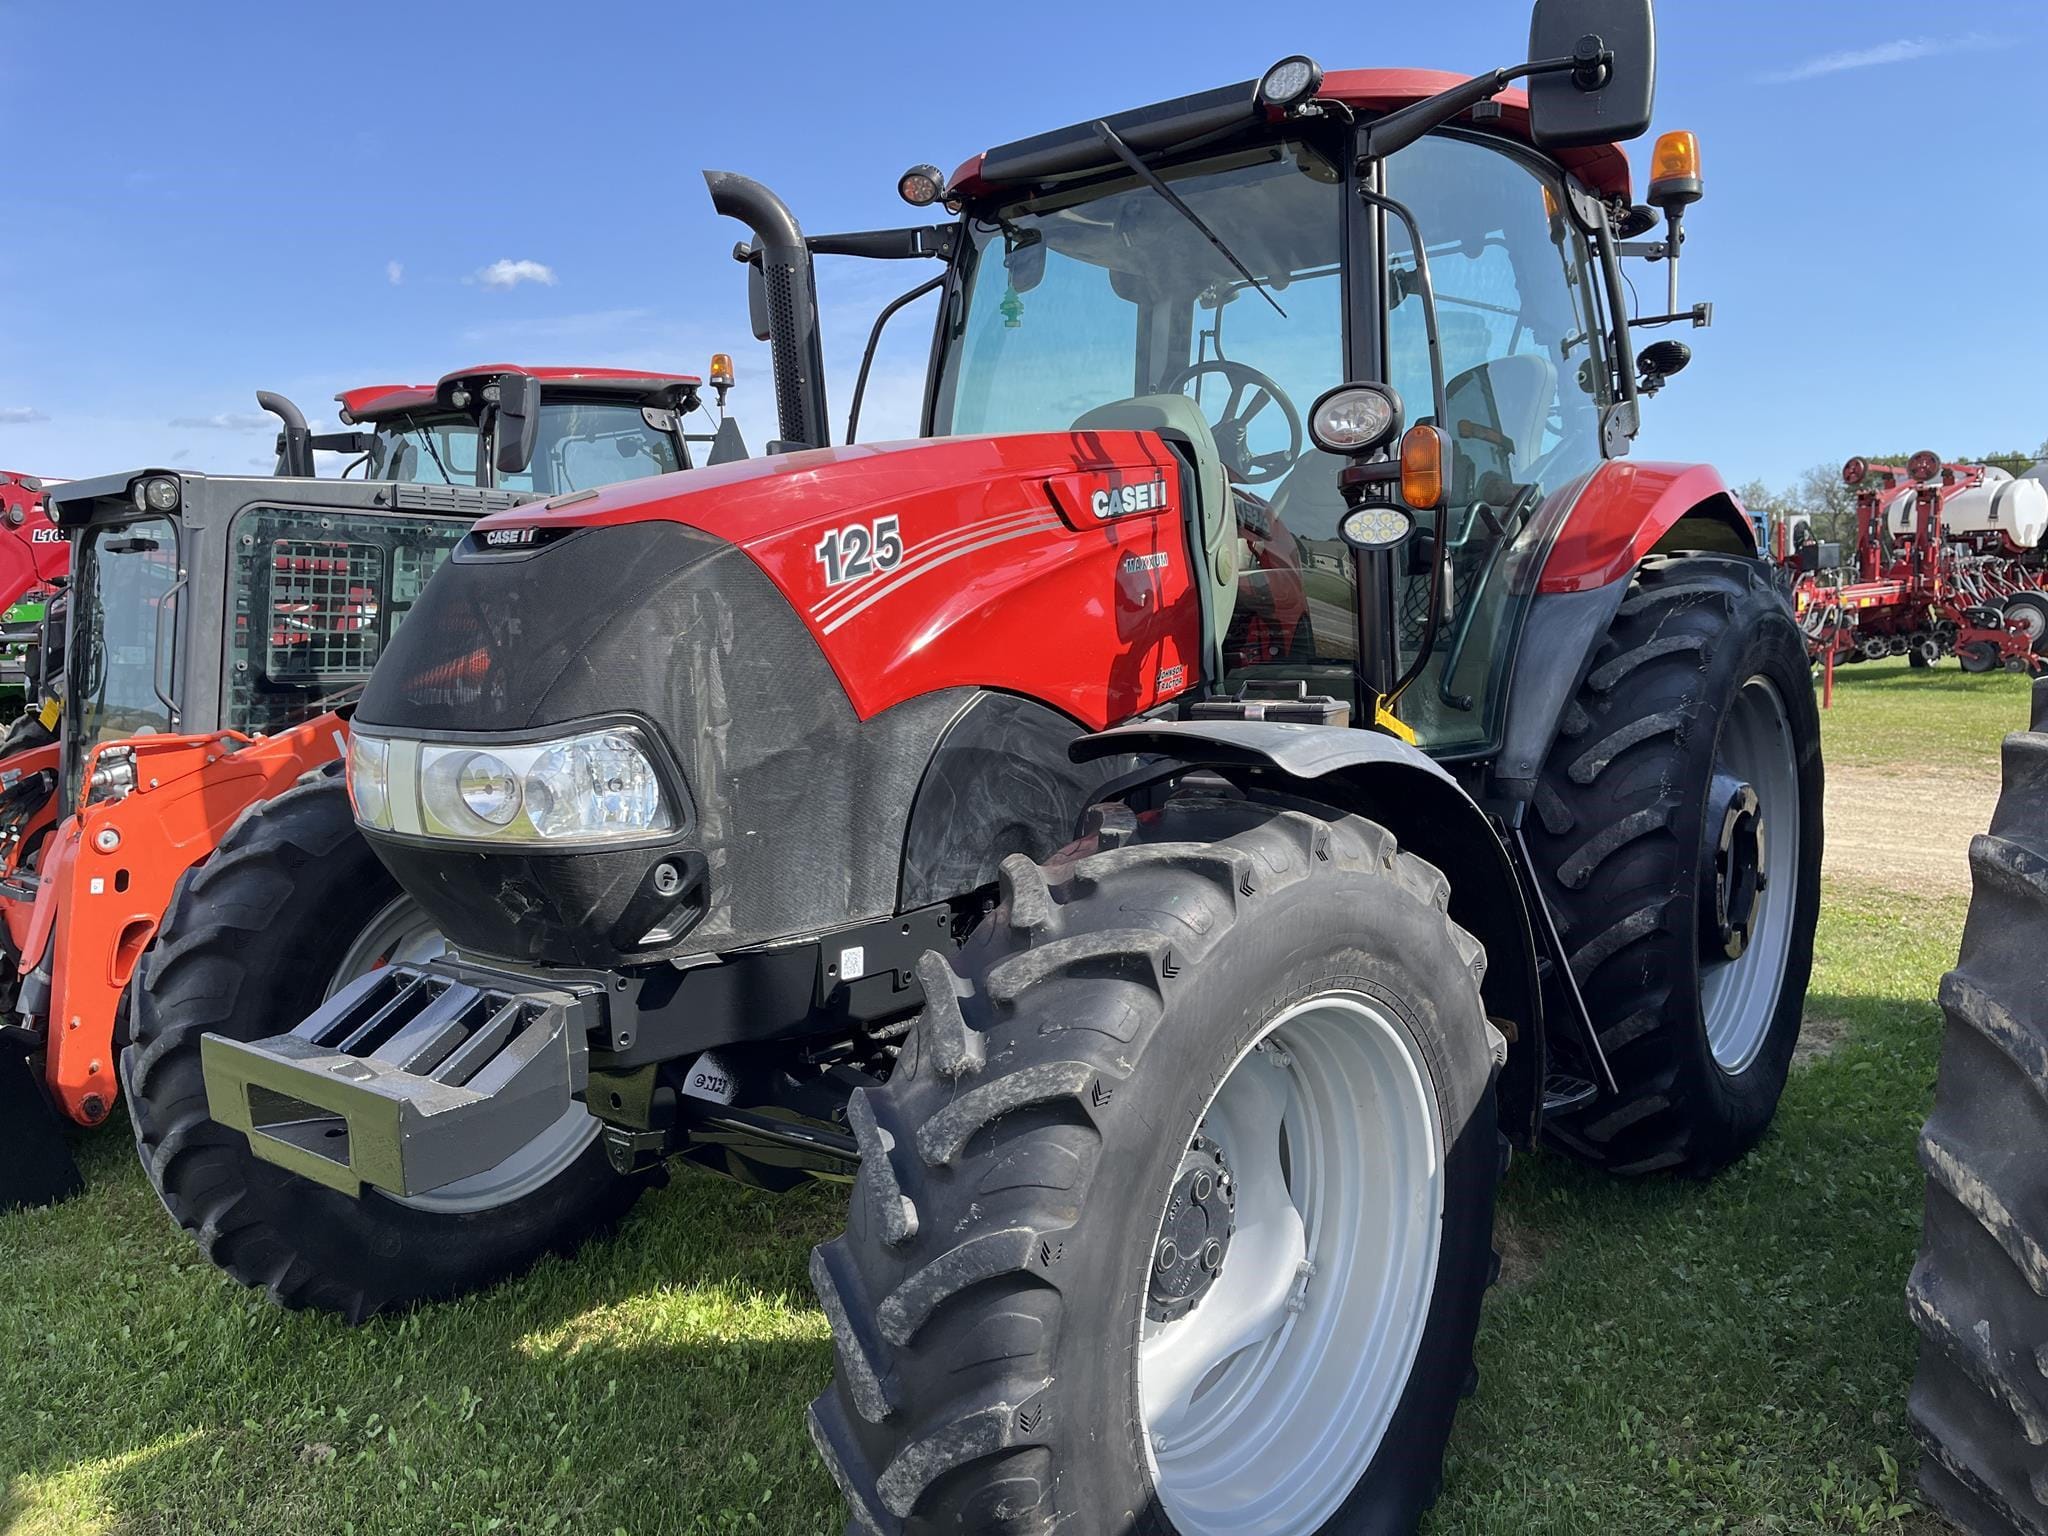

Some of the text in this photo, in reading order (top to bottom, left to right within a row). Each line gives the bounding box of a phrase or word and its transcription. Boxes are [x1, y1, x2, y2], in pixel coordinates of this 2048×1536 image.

[1092, 485, 1149, 518] CASE
[487, 529, 519, 545] CASE
[814, 513, 904, 589] 125
[1124, 552, 1168, 573] MAXXUM
[1157, 664, 1183, 681] JOHNSON
[1157, 677, 1183, 693] TRACTOR
